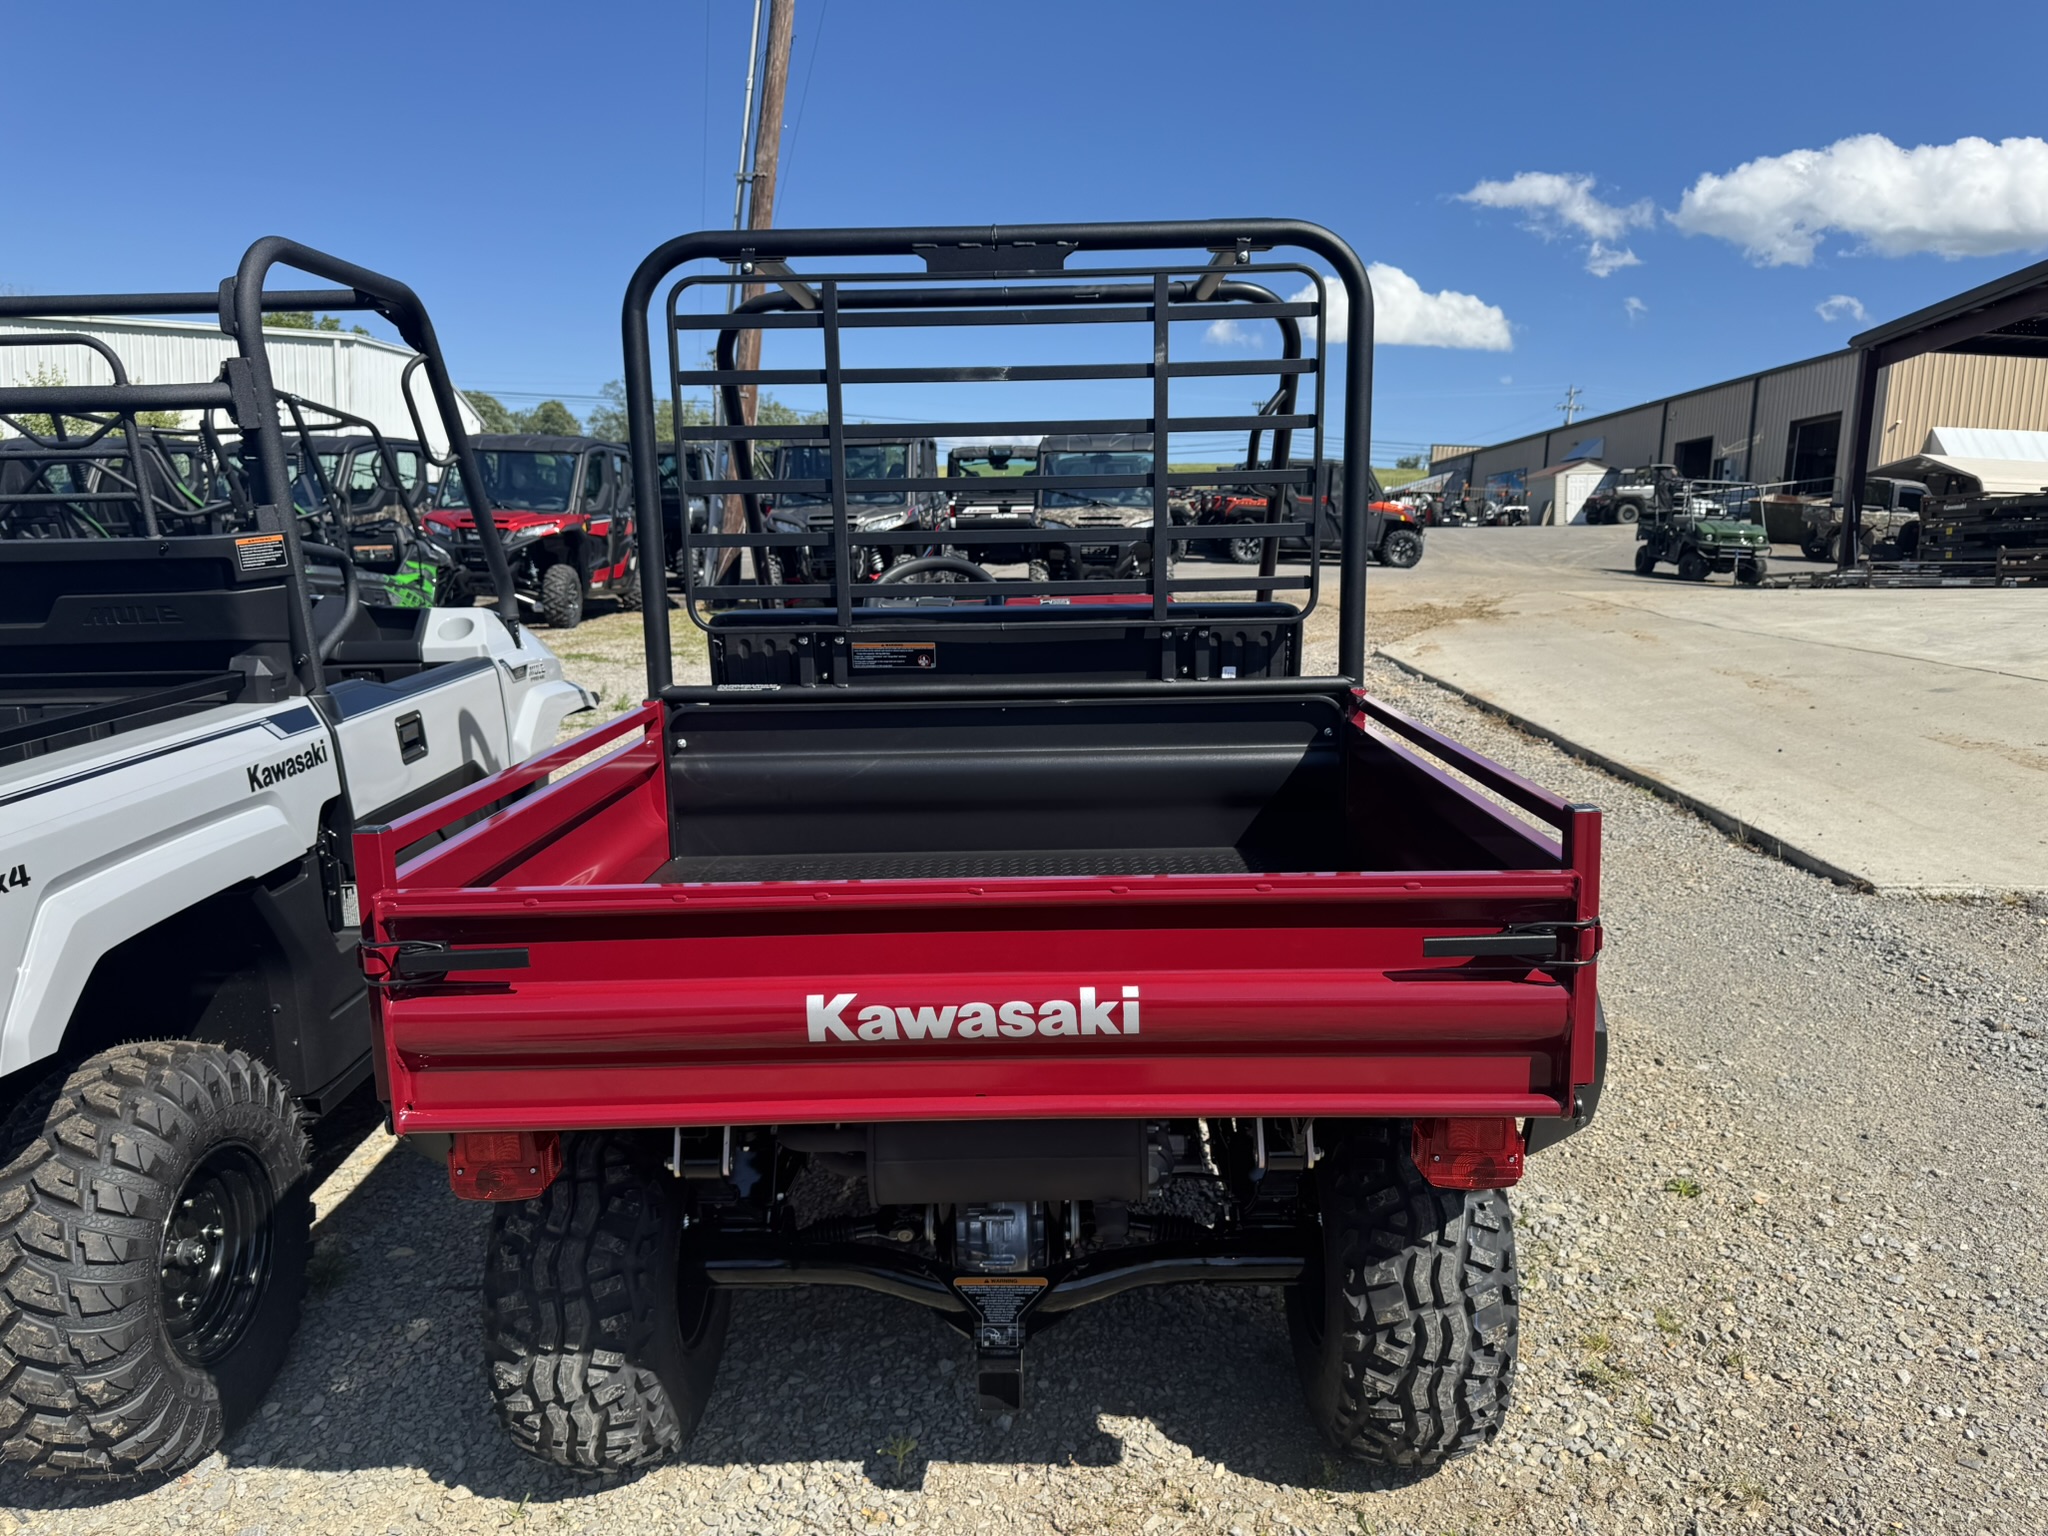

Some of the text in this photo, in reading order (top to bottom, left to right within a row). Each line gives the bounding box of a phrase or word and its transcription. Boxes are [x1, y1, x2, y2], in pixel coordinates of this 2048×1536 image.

[82, 606, 184, 626] MULE
[246, 739, 328, 793] Kawasaki
[806, 985, 1140, 1042] Kawasaki
